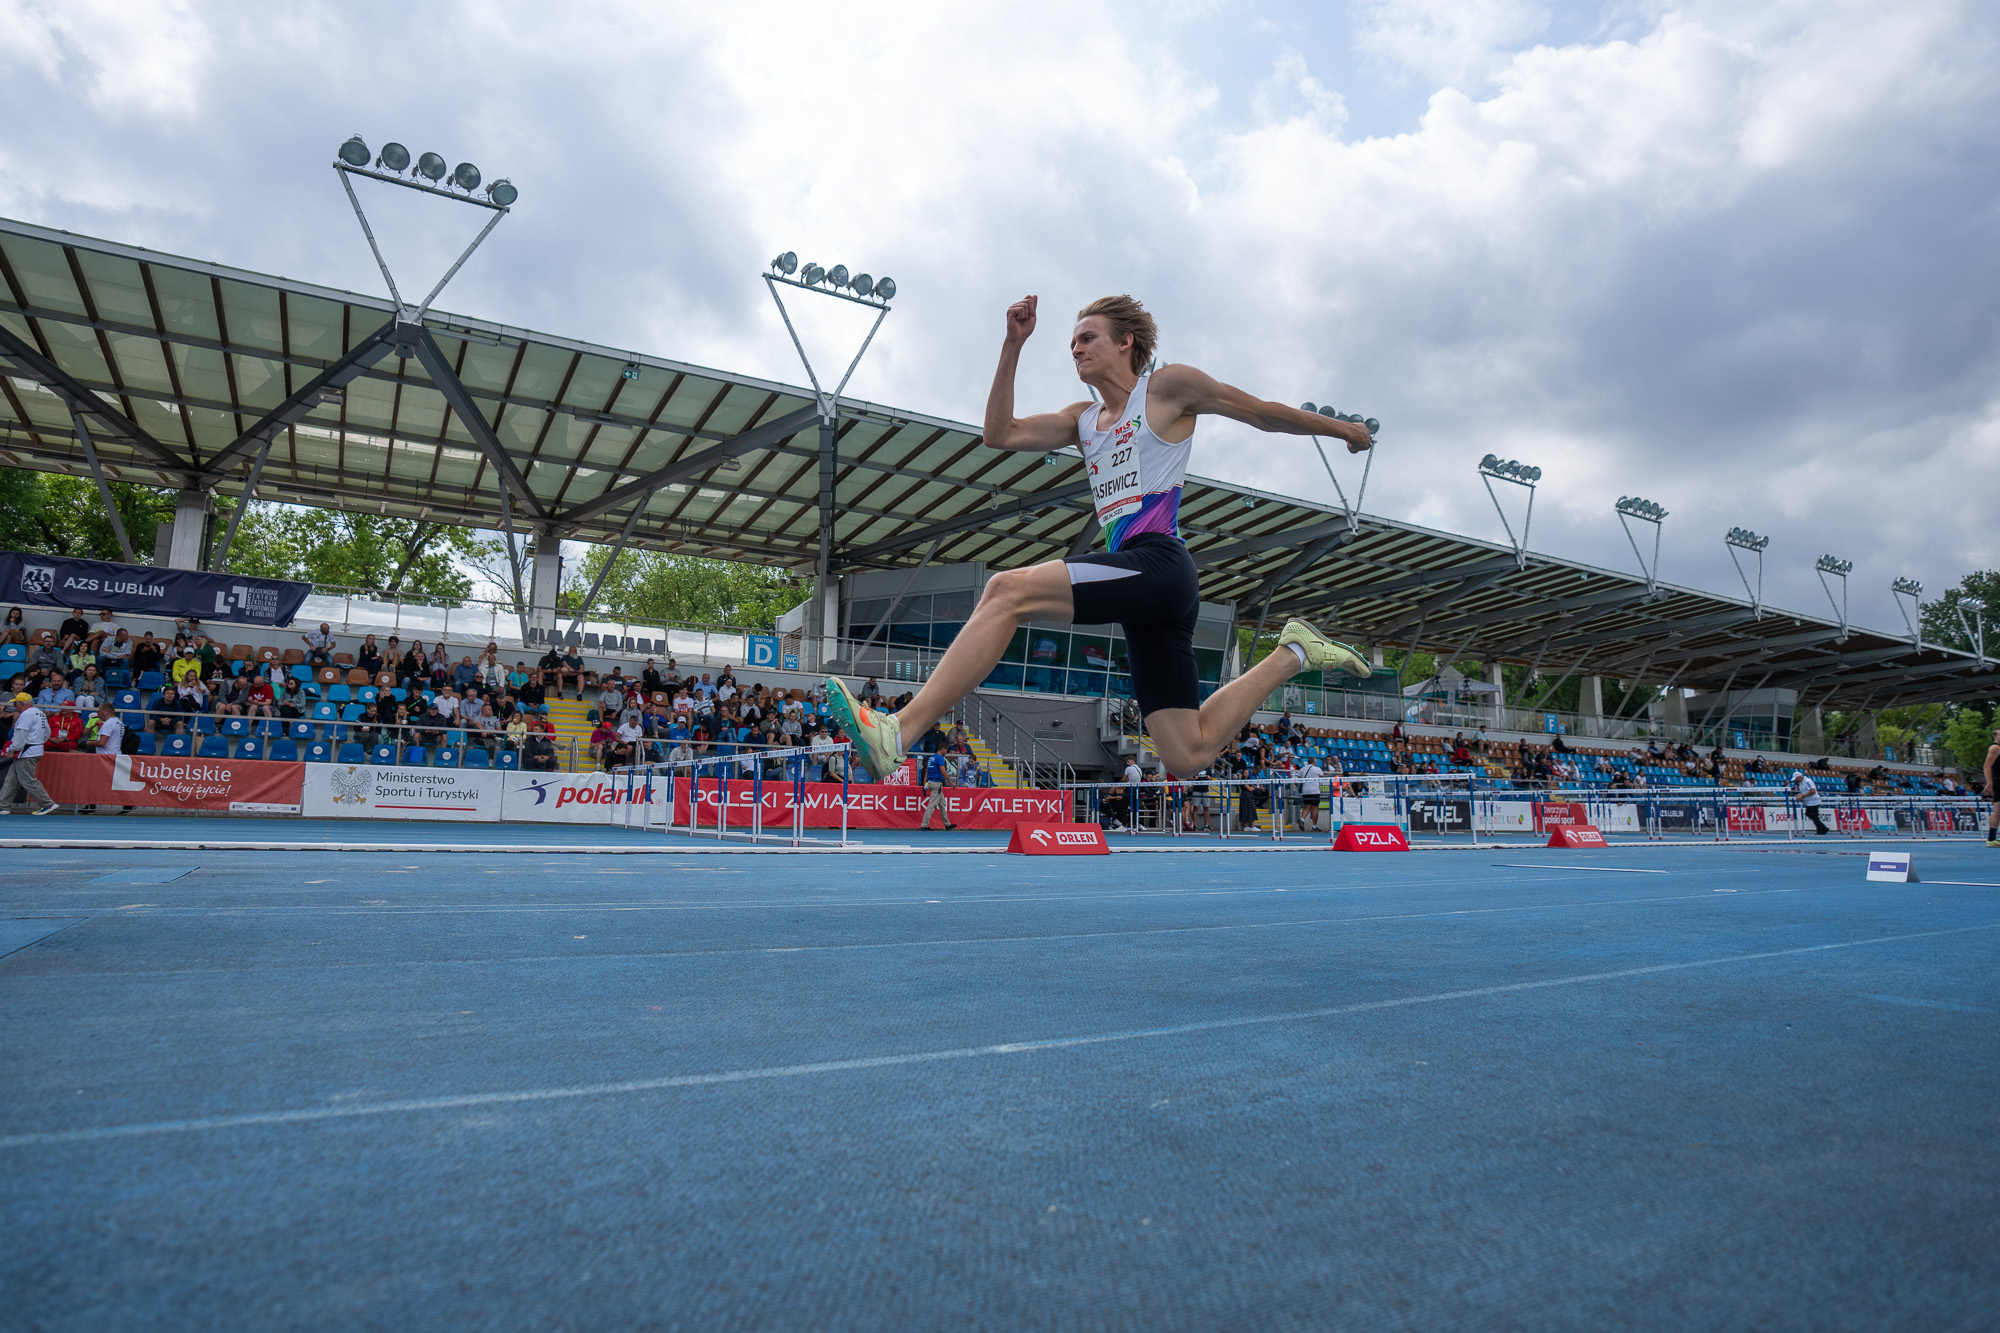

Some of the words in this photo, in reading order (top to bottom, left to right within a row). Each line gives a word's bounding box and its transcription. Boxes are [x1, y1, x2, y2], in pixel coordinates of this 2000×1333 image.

[1112, 446, 1132, 468] 227
[64, 577, 99, 591] AZS
[104, 581, 165, 597] LUBLIN
[248, 593, 278, 602] CENTRUM
[754, 644, 772, 664] D
[1549, 718, 1554, 731] F
[1737, 736, 1743, 747] G
[376, 772, 455, 785] Ministerstwo
[150, 782, 196, 801] Smakuj
[195, 783, 232, 800] życie!
[375, 786, 416, 798] Sportu
[419, 787, 422, 798] i
[426, 788, 479, 800] Turystyki
[555, 782, 657, 809] polanik
[689, 789, 776, 808] POLSKI
[894, 796, 973, 812] LEKIEJ
[978, 798, 1062, 814] ATLETYKI
[1424, 806, 1462, 823] FUEL
[1544, 814, 1560, 825] polski
[1561, 816, 1575, 825] sport
[1059, 834, 1095, 843] ORLEN
[1354, 832, 1400, 845] PZLA
